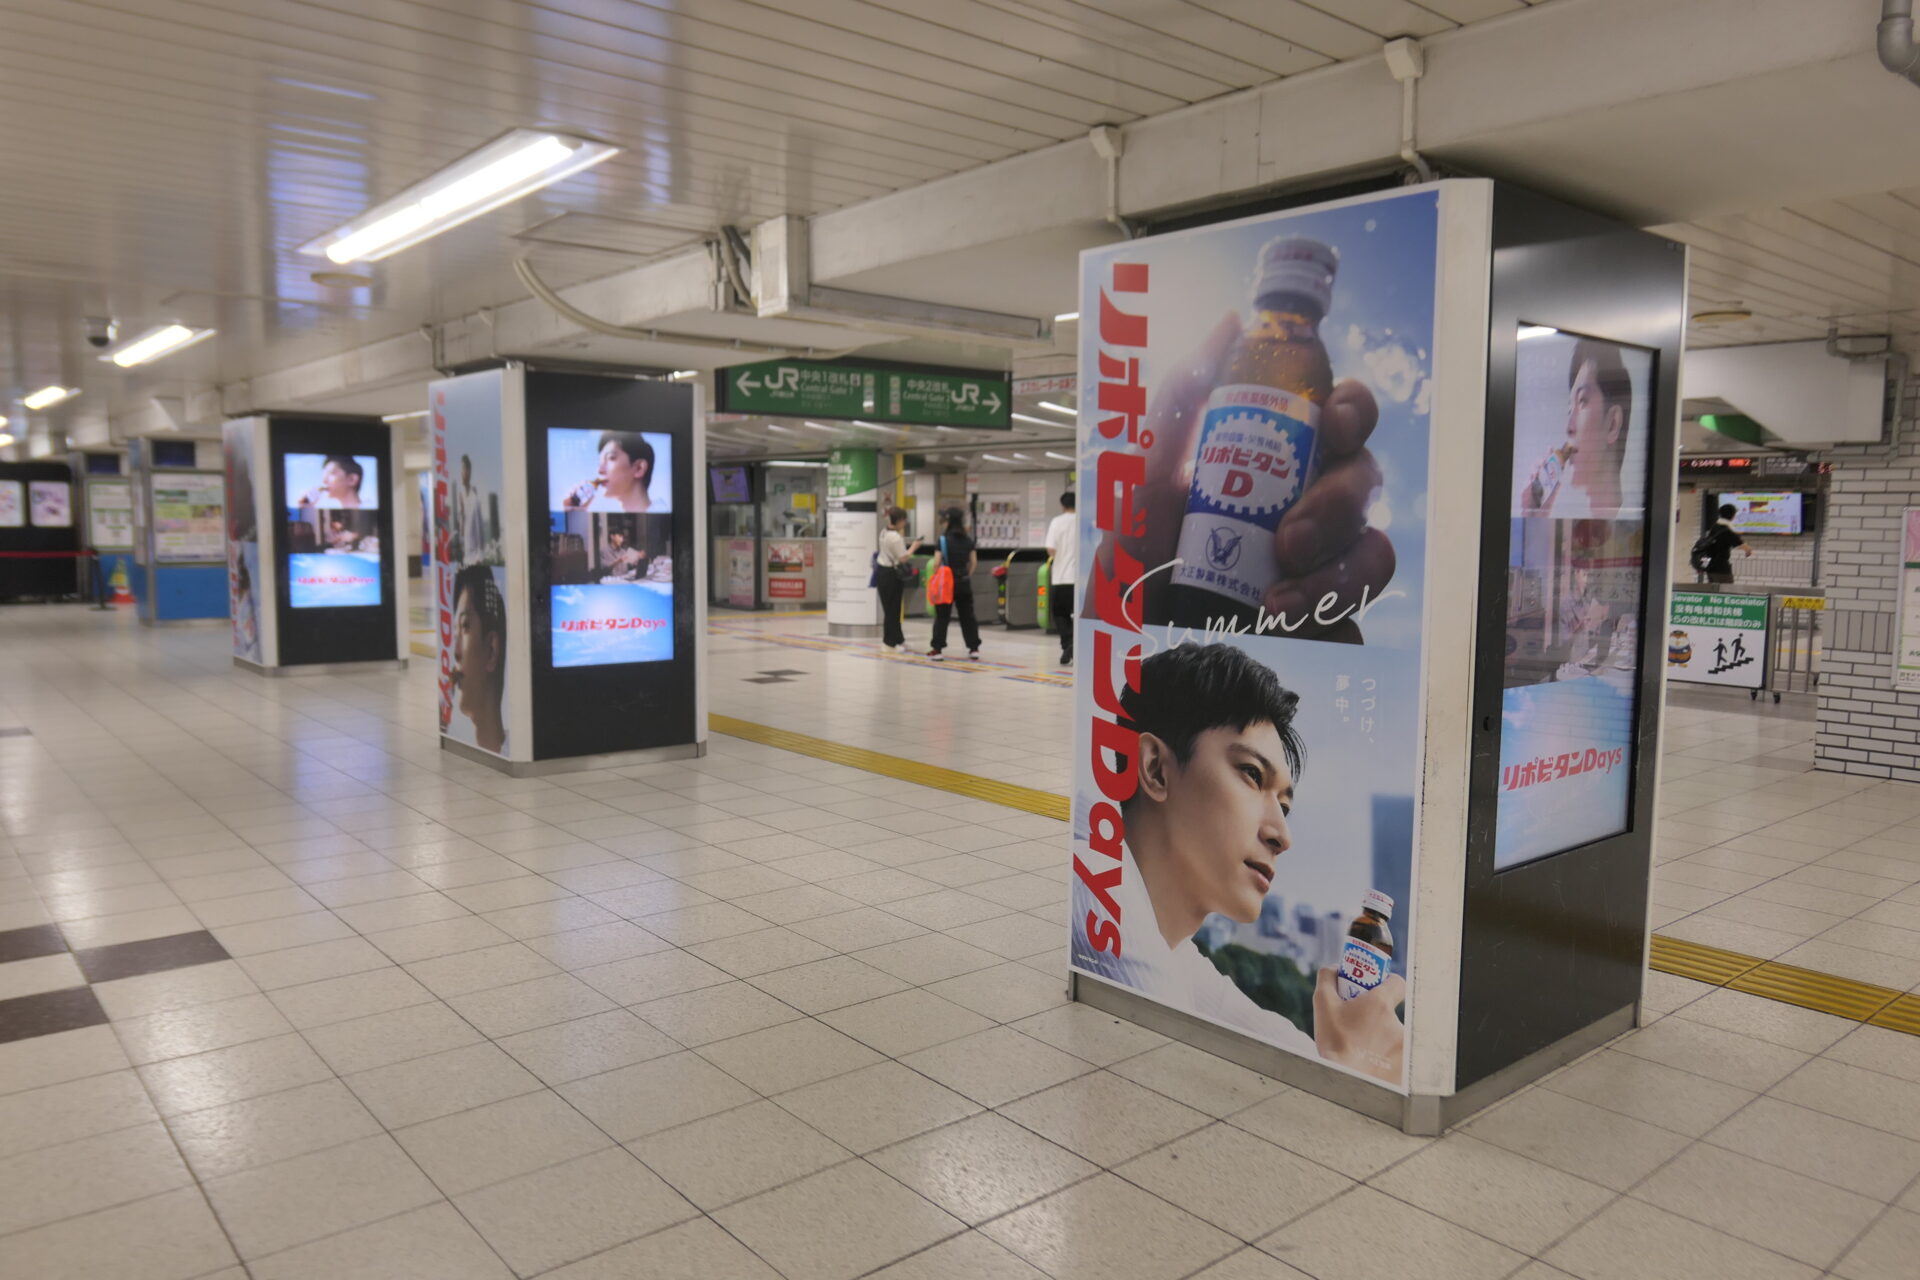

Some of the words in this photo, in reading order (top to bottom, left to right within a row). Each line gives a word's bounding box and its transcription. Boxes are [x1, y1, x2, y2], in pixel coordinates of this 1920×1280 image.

[764, 366, 799, 391] JR
[801, 382, 828, 393] Central
[830, 385, 848, 395] Gate
[902, 390, 929, 401] Central
[951, 383, 979, 405] JR
[1203, 445, 1291, 479] リポビタン
[1221, 469, 1254, 498] D
[1179, 566, 1261, 602] 大正製薬株式会社
[1073, 263, 1154, 960] リポビタンDays
[1118, 557, 1406, 661] Summer
[1672, 594, 1704, 604] levator
[1709, 596, 1723, 605] No
[1724, 596, 1766, 607] Escalator
[1503, 746, 1623, 792] リポビタンDays
[1344, 955, 1377, 976] リポビタン
[1352, 967, 1365, 979] D
